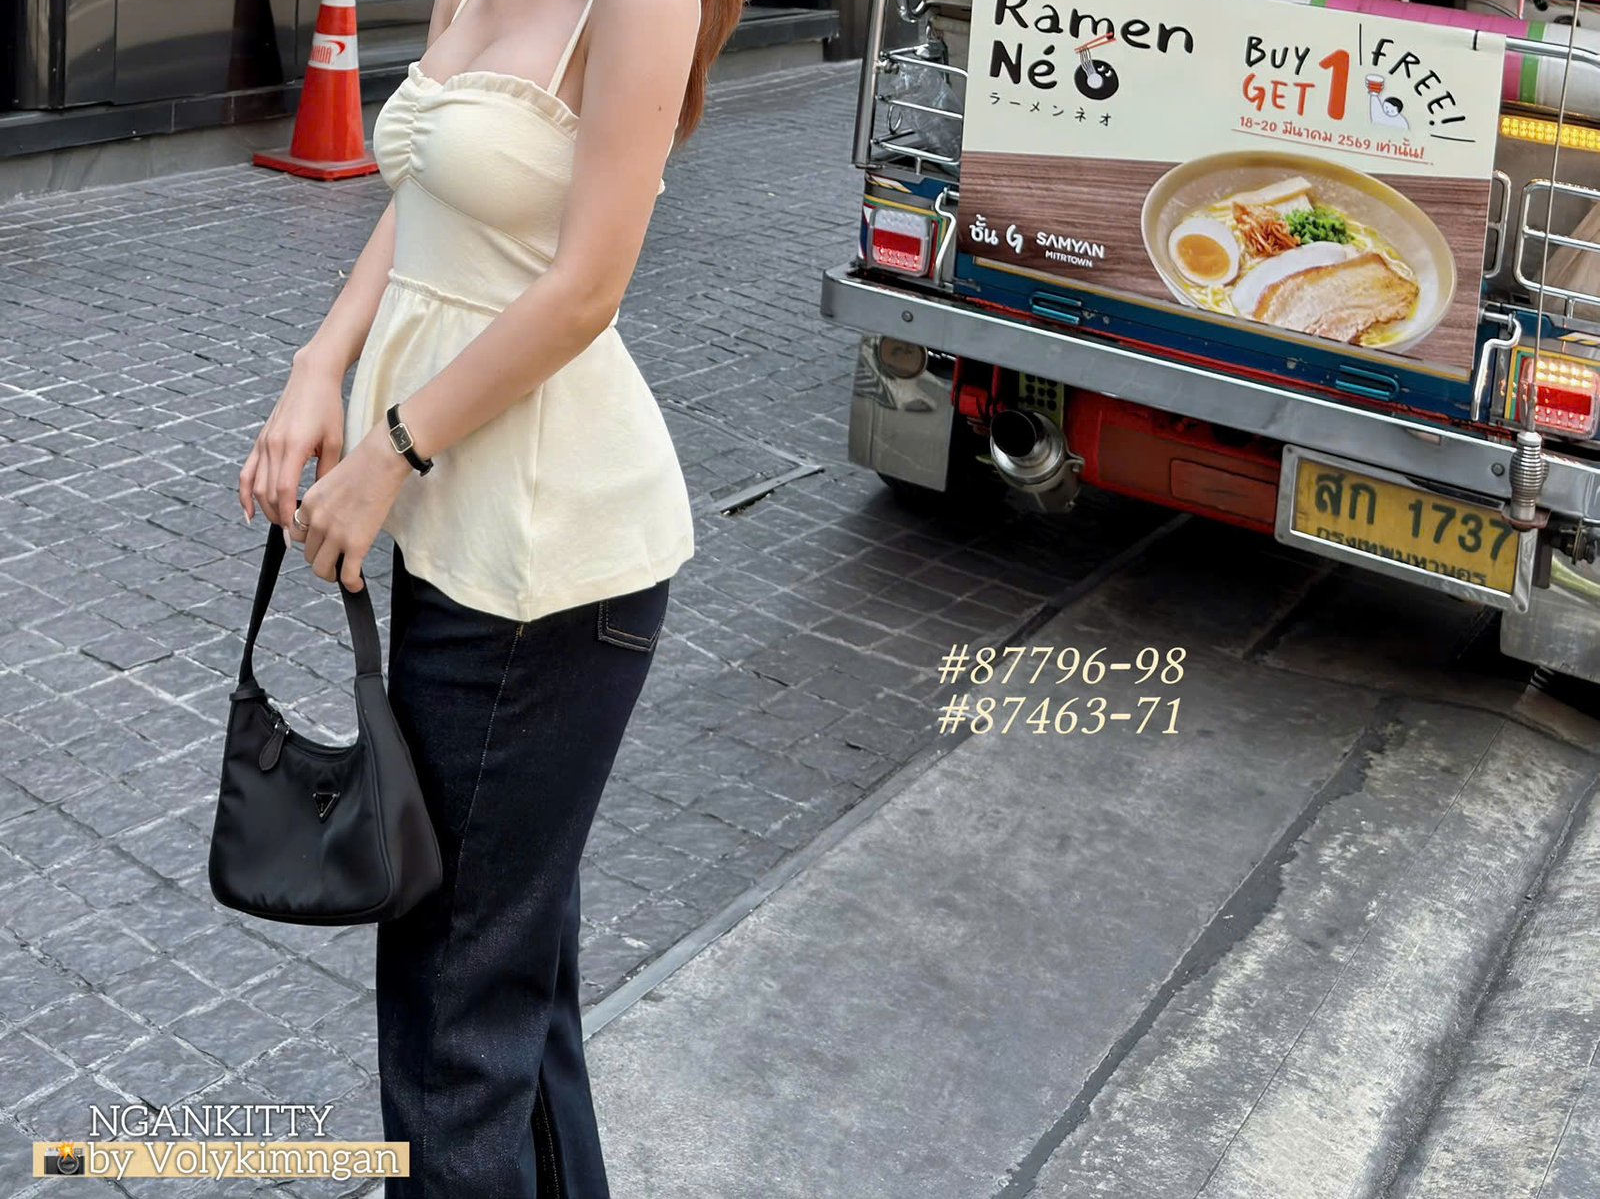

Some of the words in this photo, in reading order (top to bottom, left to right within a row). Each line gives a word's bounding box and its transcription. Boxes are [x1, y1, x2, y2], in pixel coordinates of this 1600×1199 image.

[1245, 36, 1311, 76] BUY
[1242, 72, 1316, 117] GET
[1318, 49, 1351, 121] 1
[1239, 116, 1278, 133] 18-20
[1282, 121, 1333, 143] มีนาคม
[1338, 134, 1372, 150] 2569
[969, 214, 999, 246] ชั้น
[1036, 231, 1105, 259] SAMYAN
[1045, 250, 1093, 268] MITRTOWN
[1314, 472, 1377, 525] สก
[1408, 499, 1516, 562] 1737
